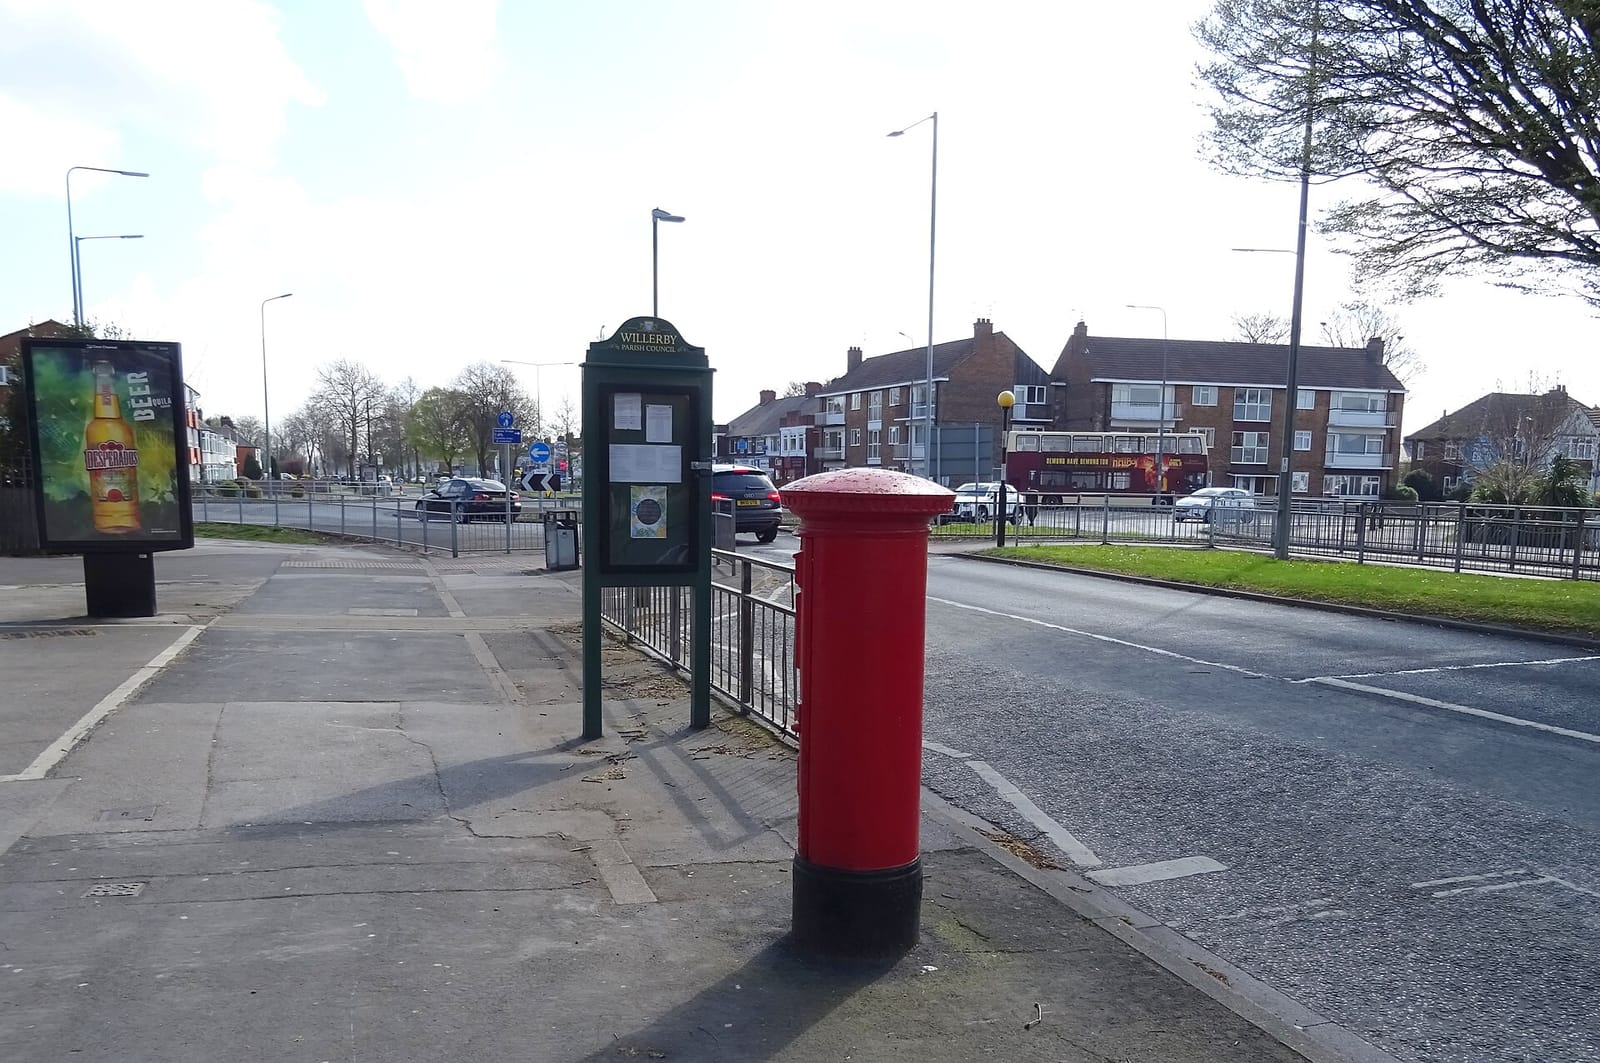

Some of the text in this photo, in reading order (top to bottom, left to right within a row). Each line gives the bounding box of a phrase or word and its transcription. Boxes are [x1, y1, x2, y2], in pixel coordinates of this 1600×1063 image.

[620, 332, 678, 345] WILLERBY
[621, 344, 677, 353] PARISH COUNCIL
[127, 371, 155, 421] BEER
[86, 450, 138, 469] DESPERADOS
